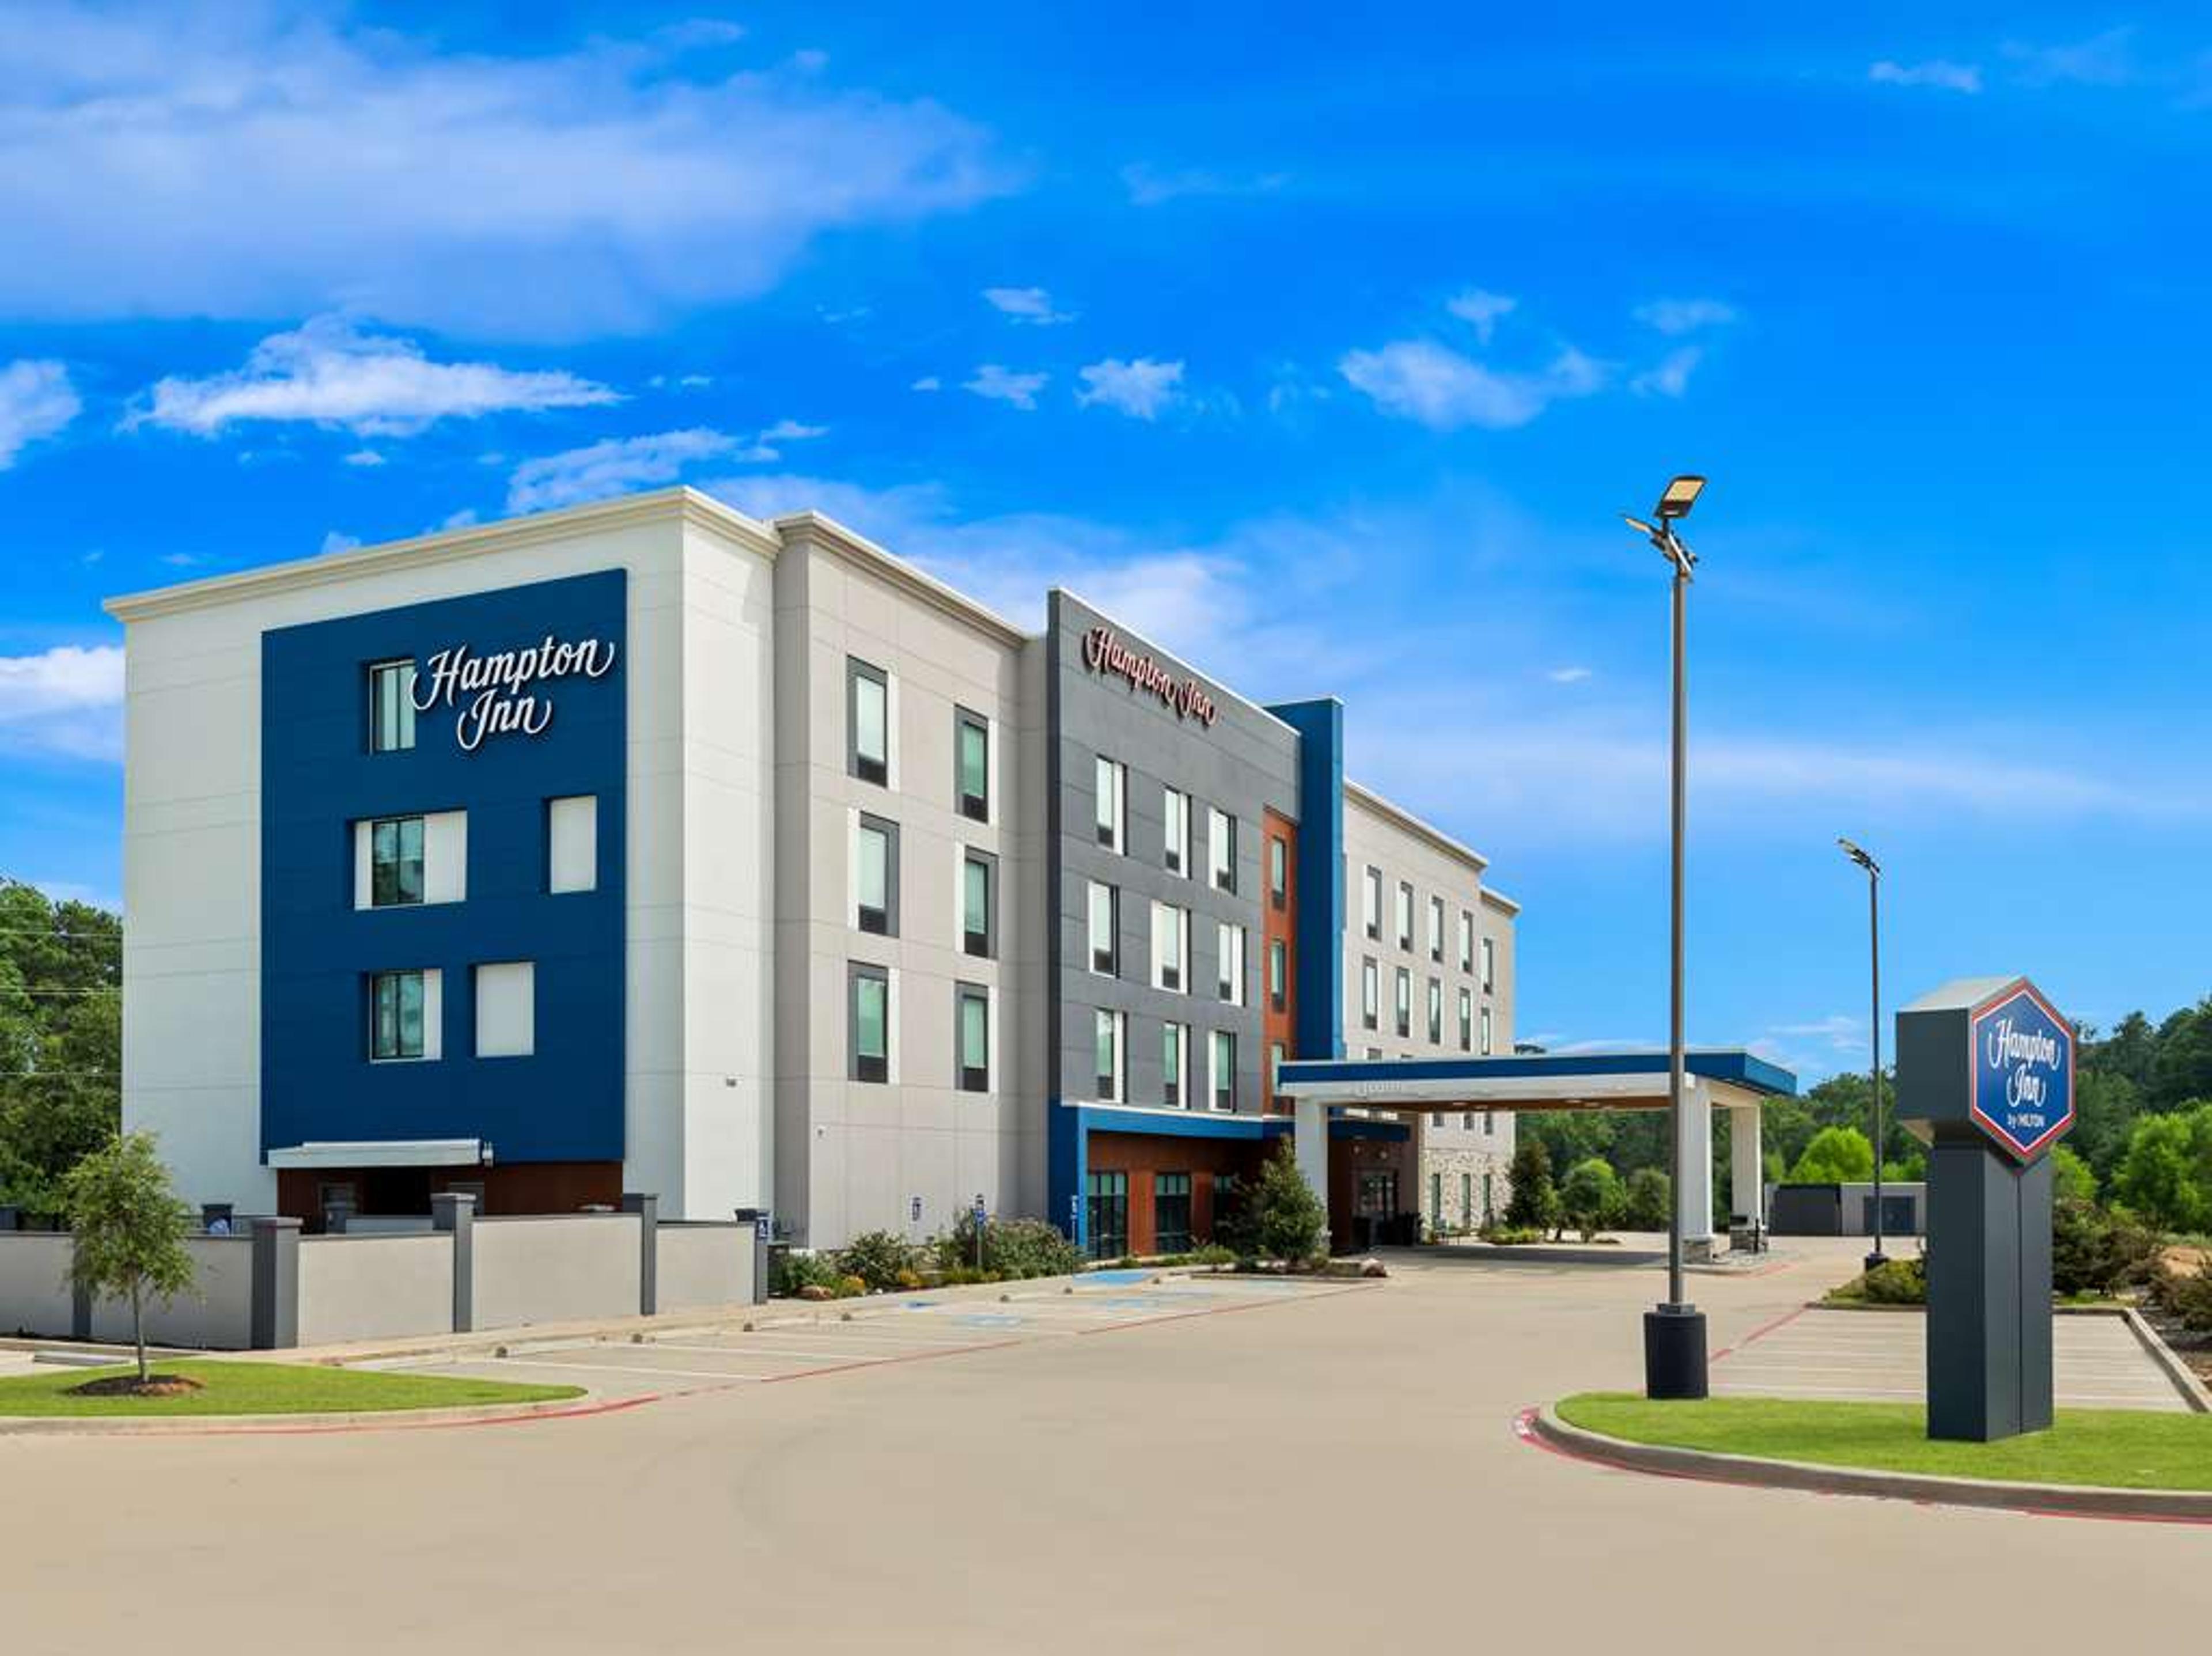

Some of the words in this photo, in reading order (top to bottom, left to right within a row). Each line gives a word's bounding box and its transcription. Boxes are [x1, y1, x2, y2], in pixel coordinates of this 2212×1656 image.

[410, 635, 615, 710] Hampton
[1083, 626, 1177, 708] Hampton
[1177, 679, 1217, 727] Inn
[457, 688, 552, 750] Inn
[1988, 1017, 2062, 1071] Hampton
[2006, 1063, 2046, 1107] Inn
